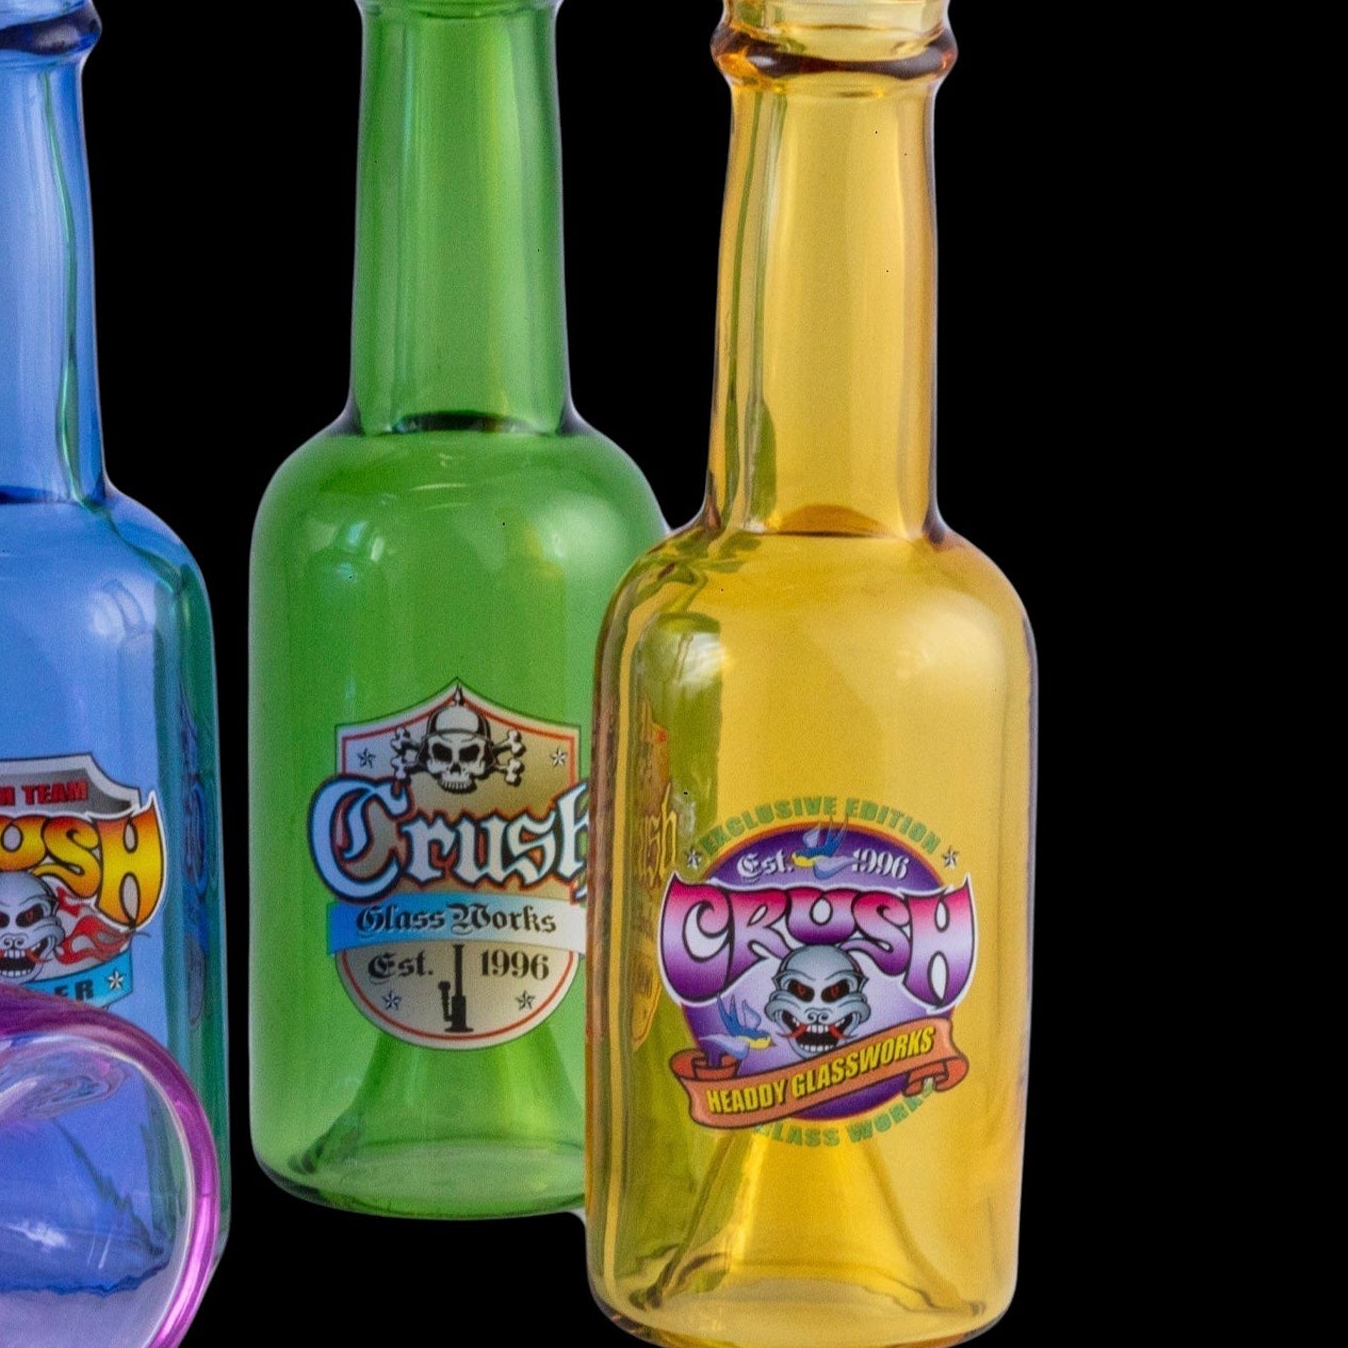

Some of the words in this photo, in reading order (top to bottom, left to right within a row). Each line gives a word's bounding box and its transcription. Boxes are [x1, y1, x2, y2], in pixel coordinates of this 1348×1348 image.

[21, 778, 89, 806] TEAM
[699, 795, 838, 856] EXCLUSIVE
[844, 796, 942, 855] EDITION
[355, 903, 445, 939] Glass
[448, 903, 557, 937] Works
[659, 873, 977, 1010] CRUSH
[367, 953, 434, 986] Est.
[479, 949, 550, 981] 1996
[791, 1026, 936, 1099] GLASSWORKS
